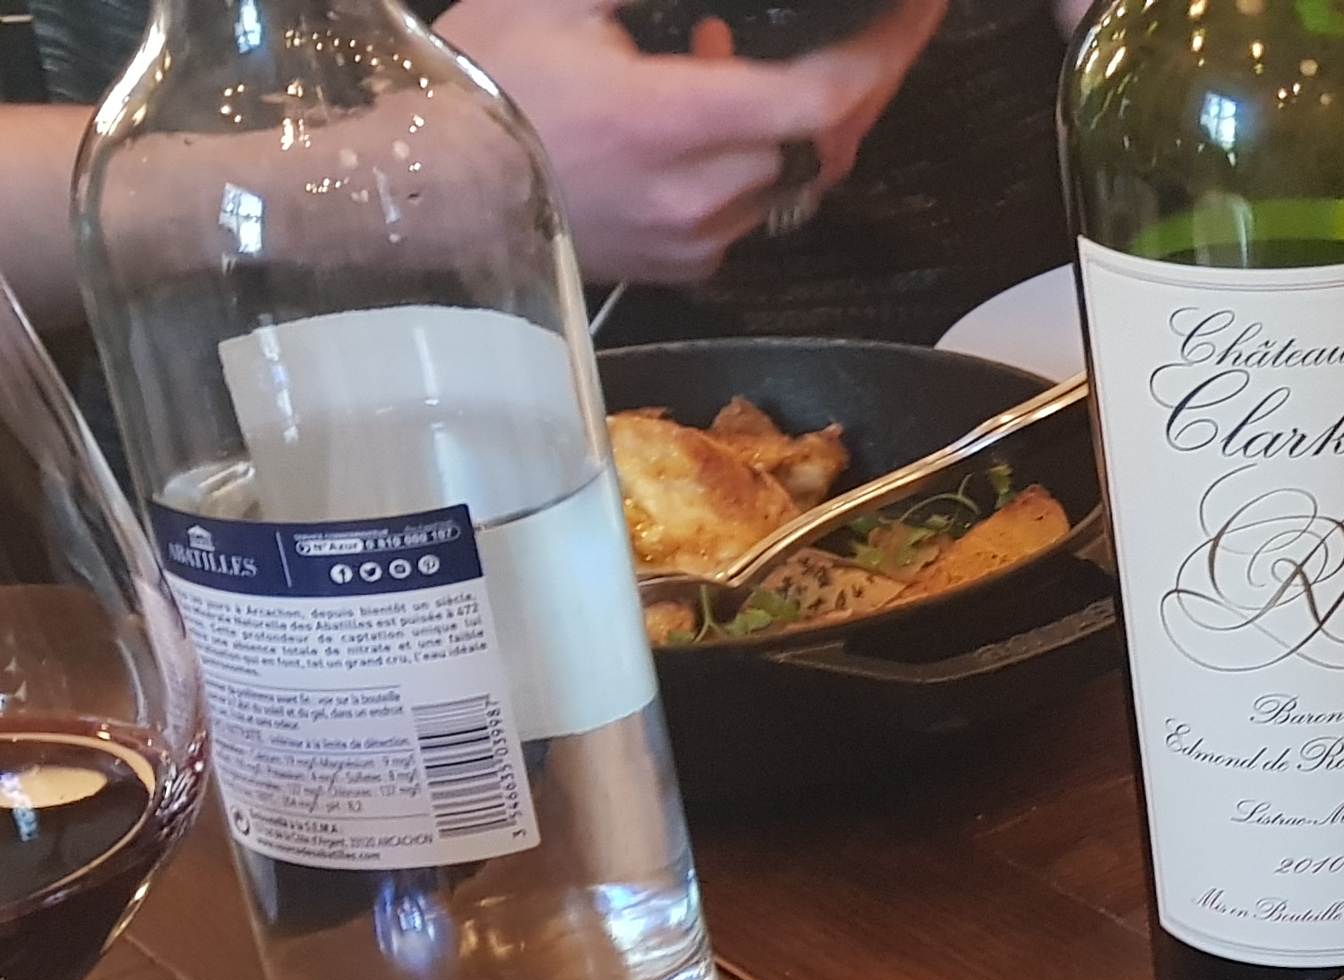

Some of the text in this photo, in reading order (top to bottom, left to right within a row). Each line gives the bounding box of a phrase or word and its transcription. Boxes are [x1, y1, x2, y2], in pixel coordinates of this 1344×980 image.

[1250, 693, 1344, 725] Baron
[1165, 717, 1267, 771] Edmond
[1261, 747, 1291, 772] de
[1191, 888, 1227, 914] Mis
[1229, 906, 1249, 918] en
